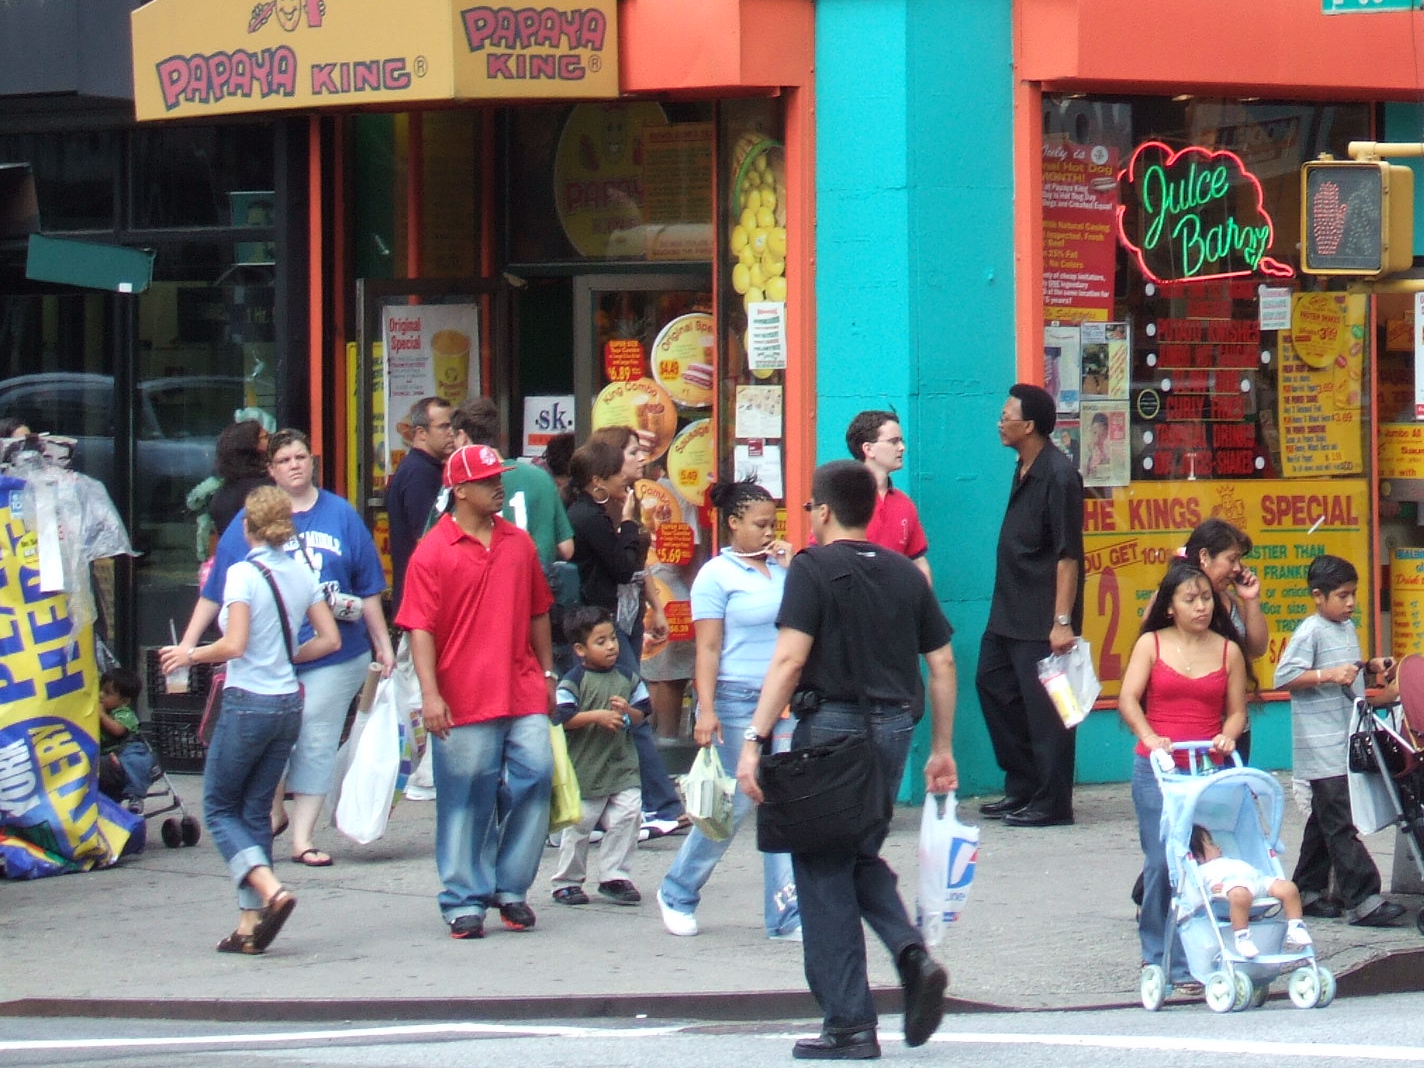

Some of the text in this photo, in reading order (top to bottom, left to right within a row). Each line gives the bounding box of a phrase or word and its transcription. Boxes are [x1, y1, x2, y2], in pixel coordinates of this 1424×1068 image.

[460, 6, 607, 53] PAPAYA
[155, 44, 412, 111] PAPAYA KING
[486, 53, 586, 81] KING
[1089, 164, 1113, 176] Dog
[389, 317, 421, 335] Original
[391, 335, 421, 355] Special
[1083, 493, 1360, 532] HE KINGS SPECIAL
[1109, 541, 1139, 566] GET
[1245, 544, 1326, 560] ASTIER THAN
[1287, 602, 1306, 615] size
[1097, 565, 1121, 682] 2
